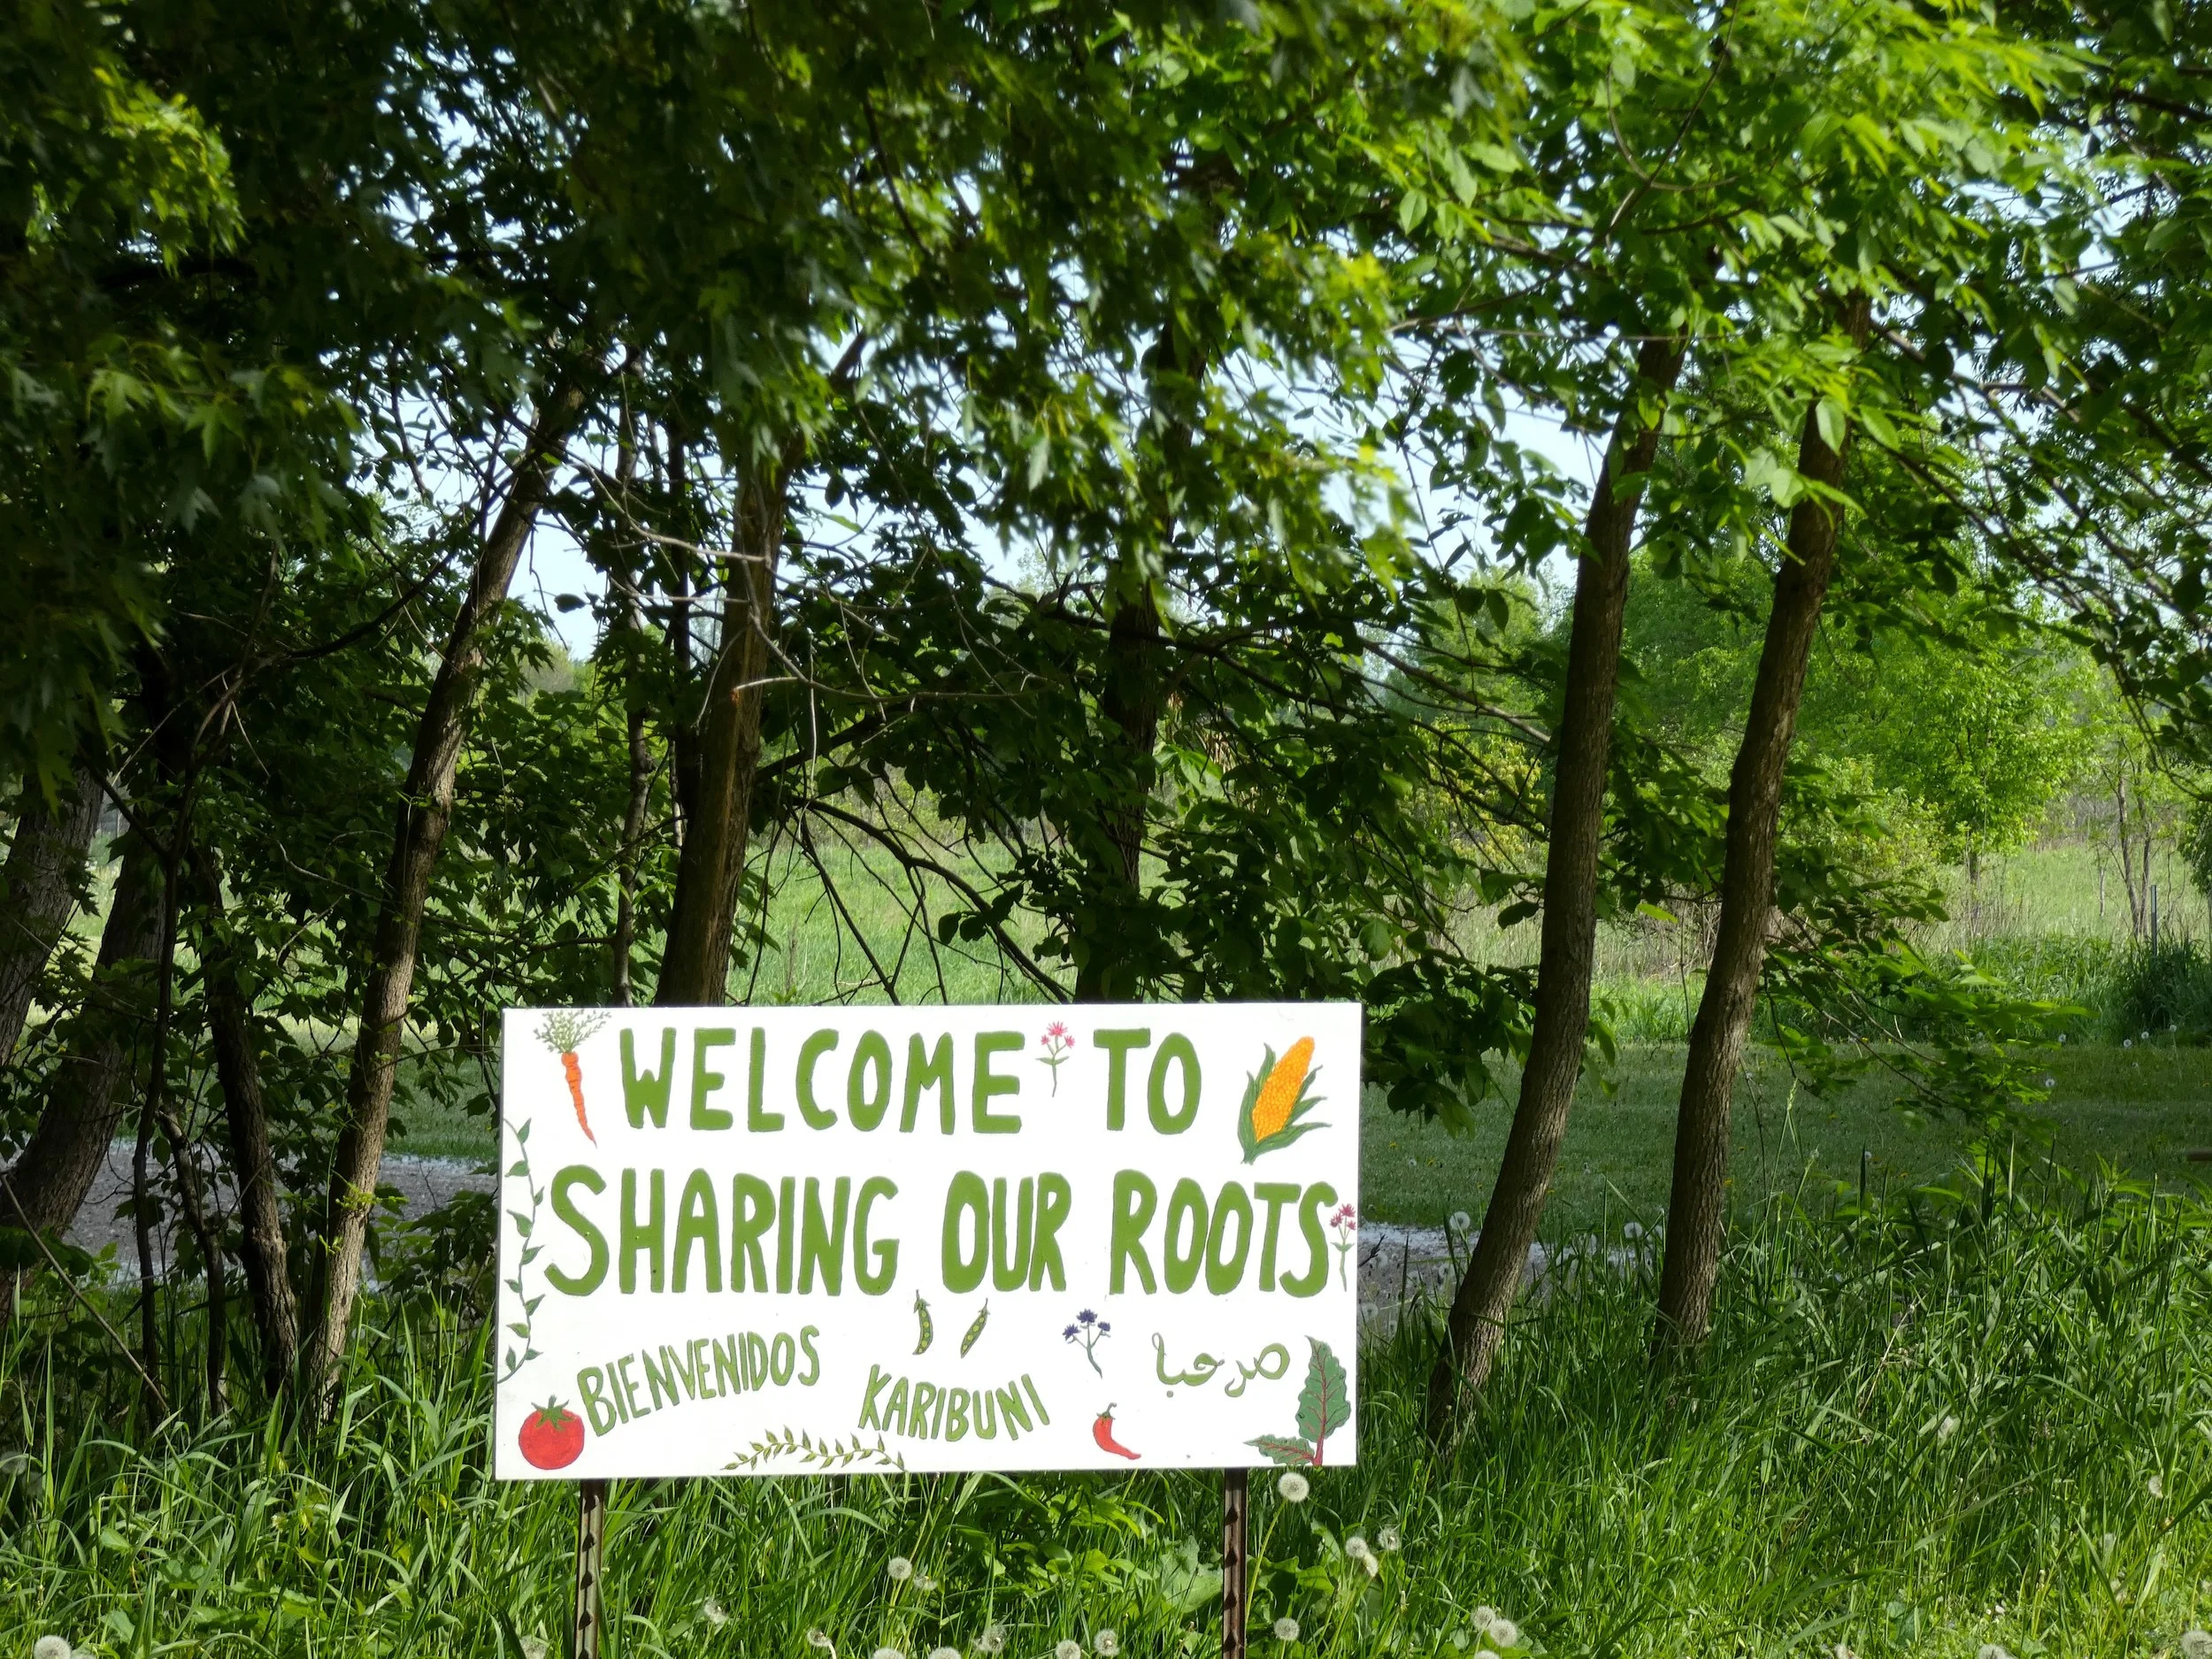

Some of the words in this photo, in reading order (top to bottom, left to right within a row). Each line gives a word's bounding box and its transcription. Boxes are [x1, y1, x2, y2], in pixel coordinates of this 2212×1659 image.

[620, 1027, 1025, 1133] WELCOME
[1094, 1027, 1202, 1134] TO
[543, 1164, 900, 1296] SHARING
[941, 1171, 1071, 1294] OUR
[1110, 1168, 1338, 1297] ROOTS
[577, 1325, 820, 1437] BIENVENIDOS
[857, 1363, 1051, 1443] KARIBUNI
